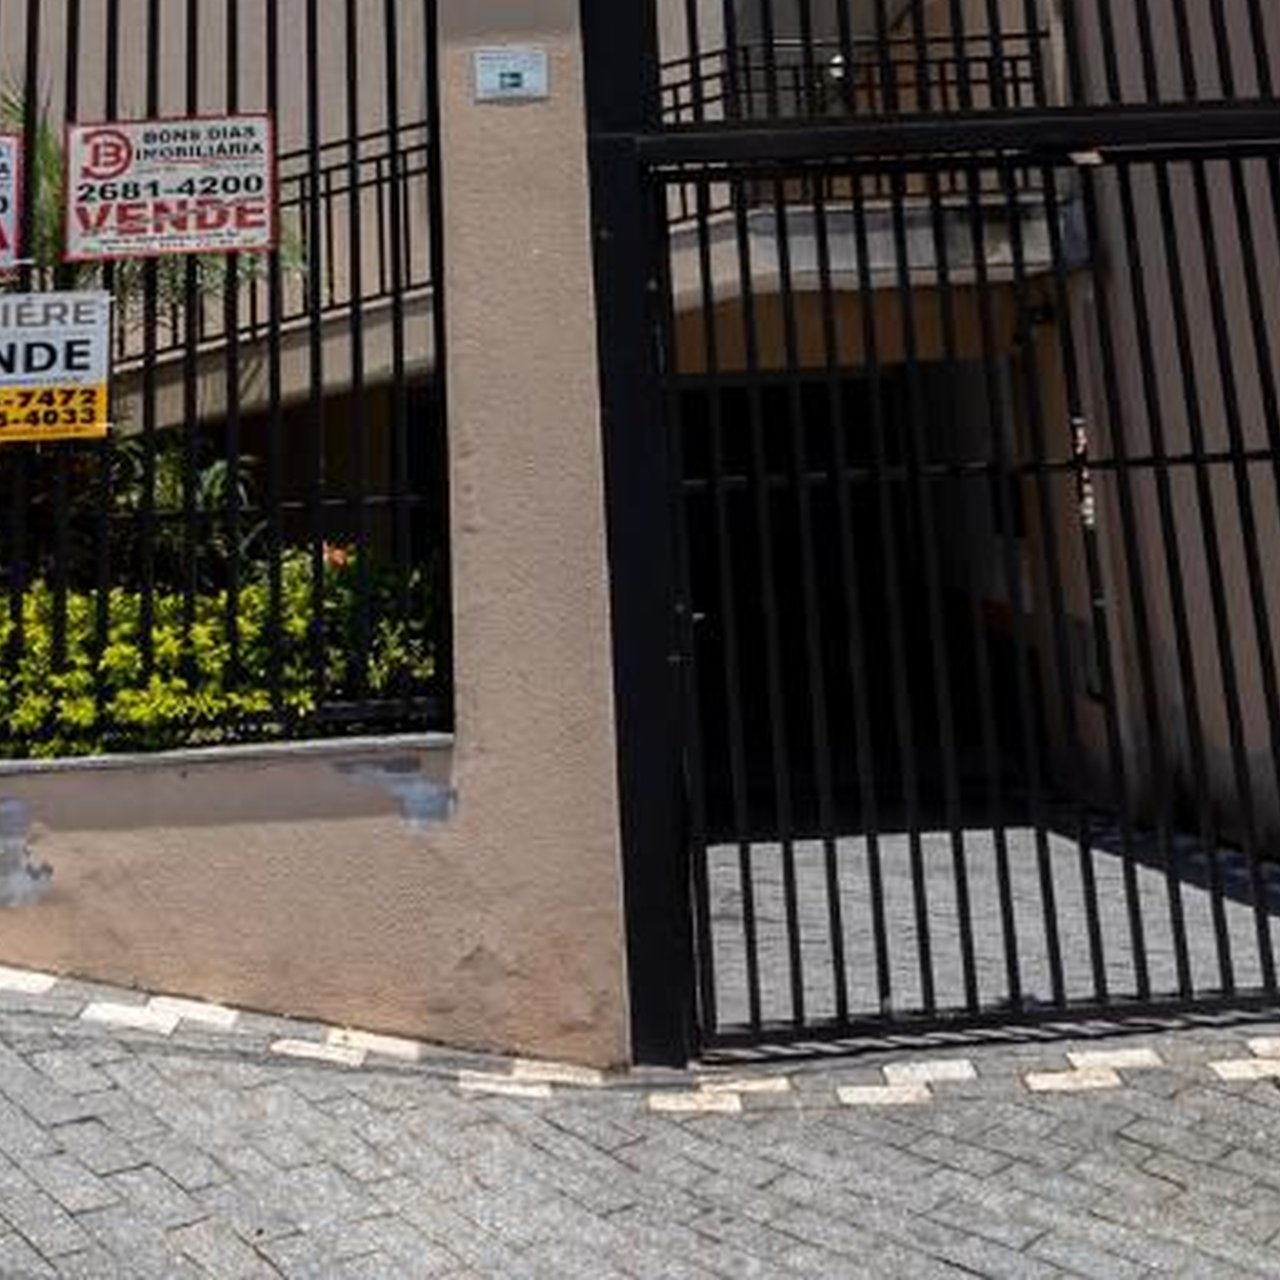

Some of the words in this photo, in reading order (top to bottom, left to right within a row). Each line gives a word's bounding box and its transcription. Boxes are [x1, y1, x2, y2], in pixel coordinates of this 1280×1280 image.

[207, 125, 256, 140] DIAS
[77, 175, 263, 202] 2681-4200
[75, 200, 266, 235] VENDE
